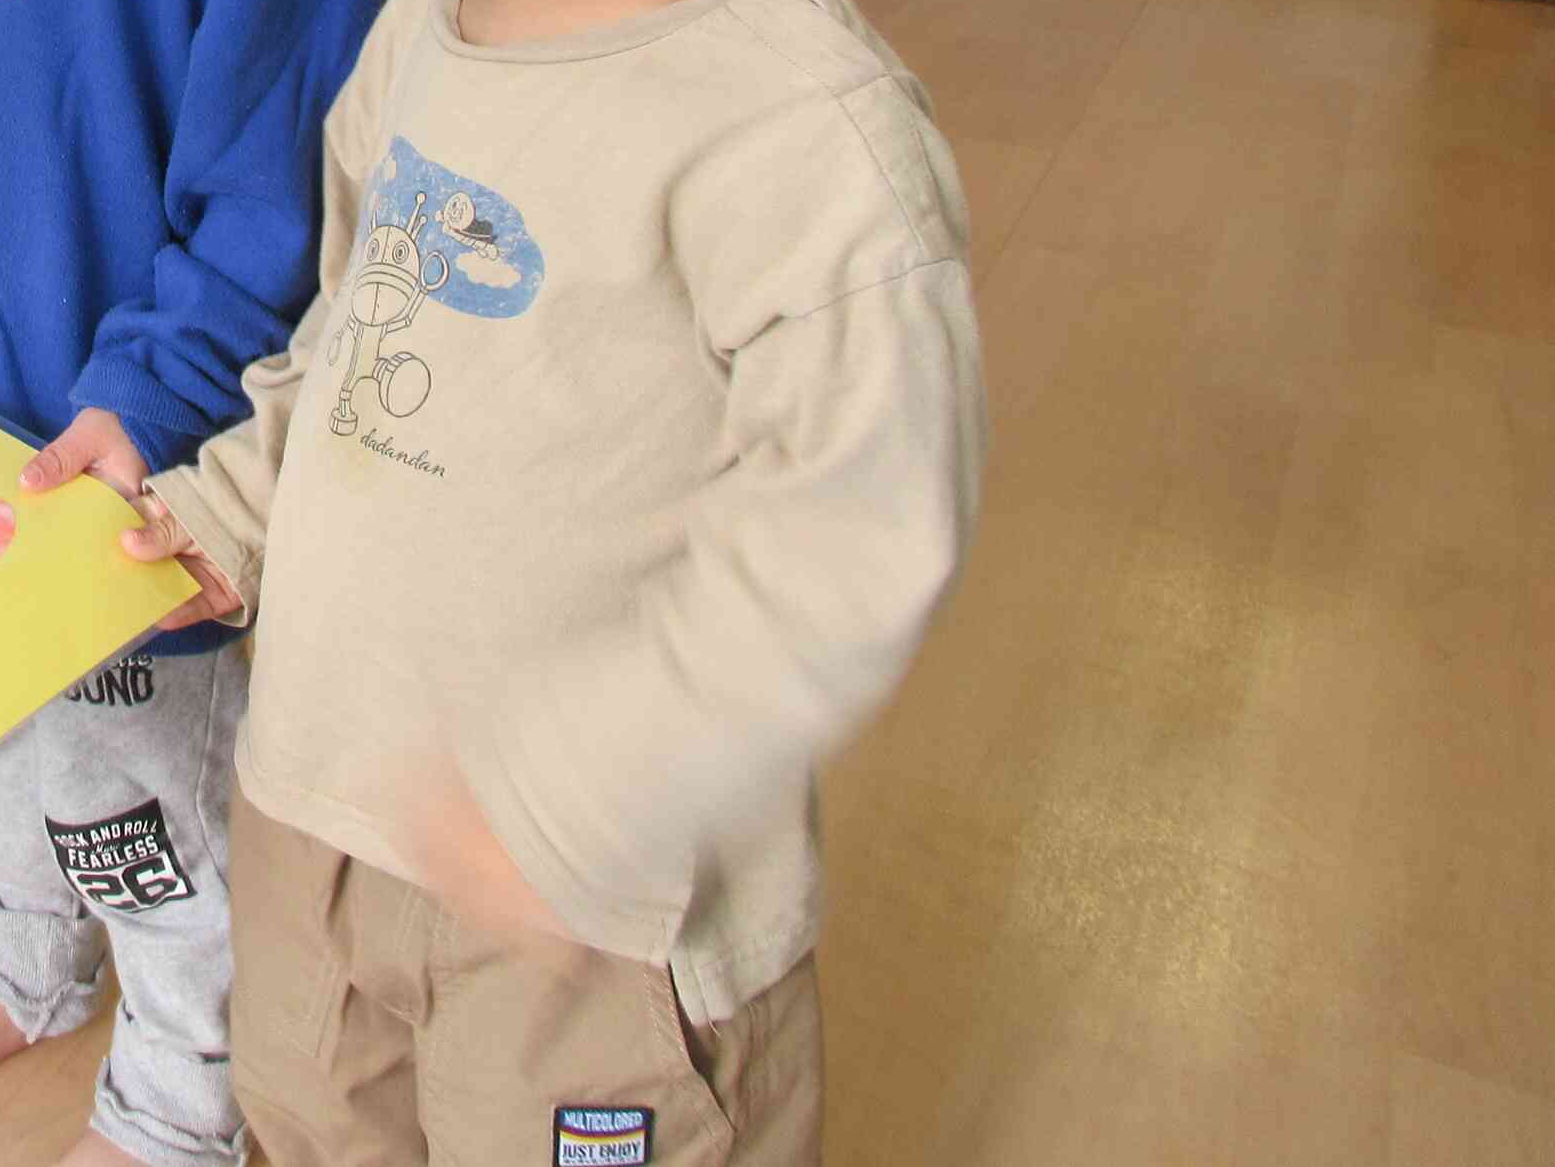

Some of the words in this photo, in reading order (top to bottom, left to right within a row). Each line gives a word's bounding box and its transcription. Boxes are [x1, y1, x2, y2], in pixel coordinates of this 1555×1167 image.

[360, 428, 445, 477] dadandan
[90, 823, 120, 844] AND
[124, 819, 158, 836] ROLL
[68, 835, 158, 868] FEARLESS
[76, 856, 179, 910] 26
[563, 1143, 595, 1158] JUST
[599, 1140, 641, 1159] ENJOY
